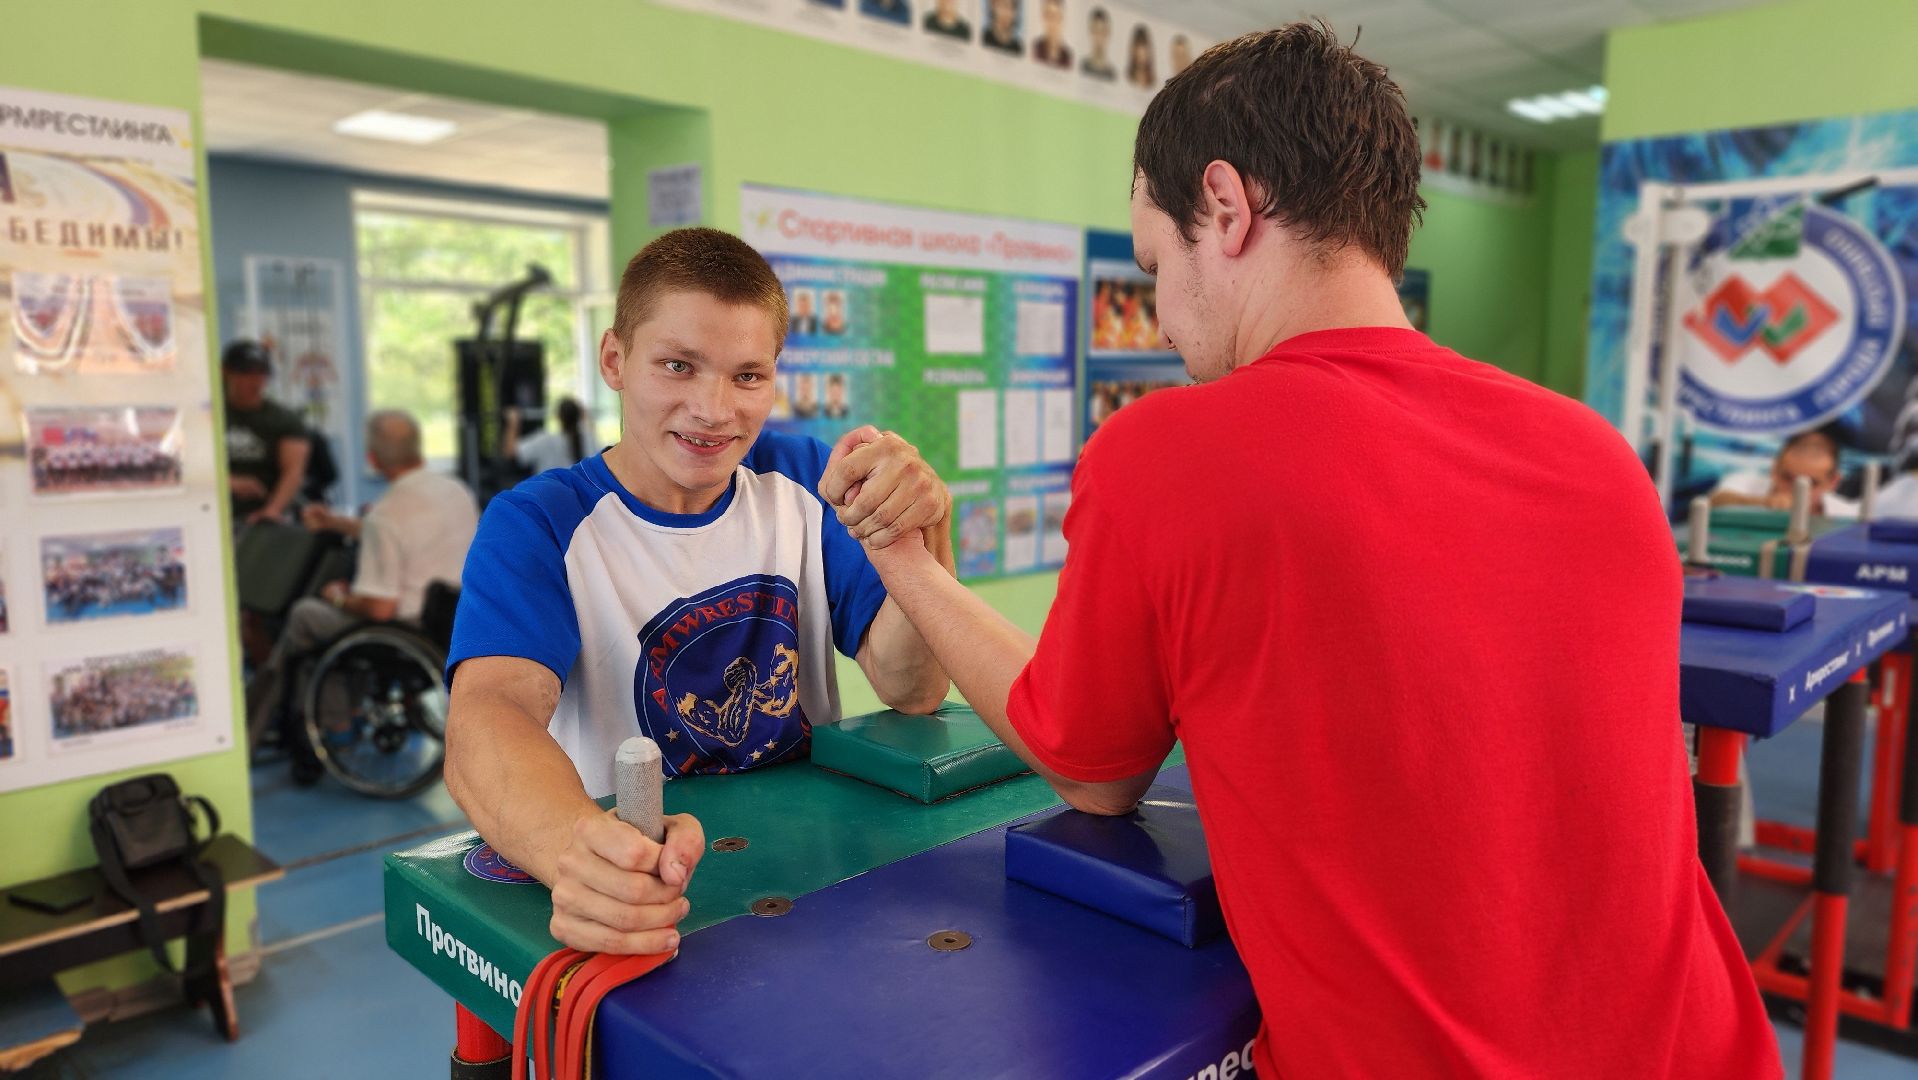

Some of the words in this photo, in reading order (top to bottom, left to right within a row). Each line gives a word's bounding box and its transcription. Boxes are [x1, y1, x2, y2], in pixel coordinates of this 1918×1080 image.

[777, 208, 913, 245] Спортивная
[1856, 563, 1908, 582] АРМ
[415, 902, 523, 1008] Протвино
